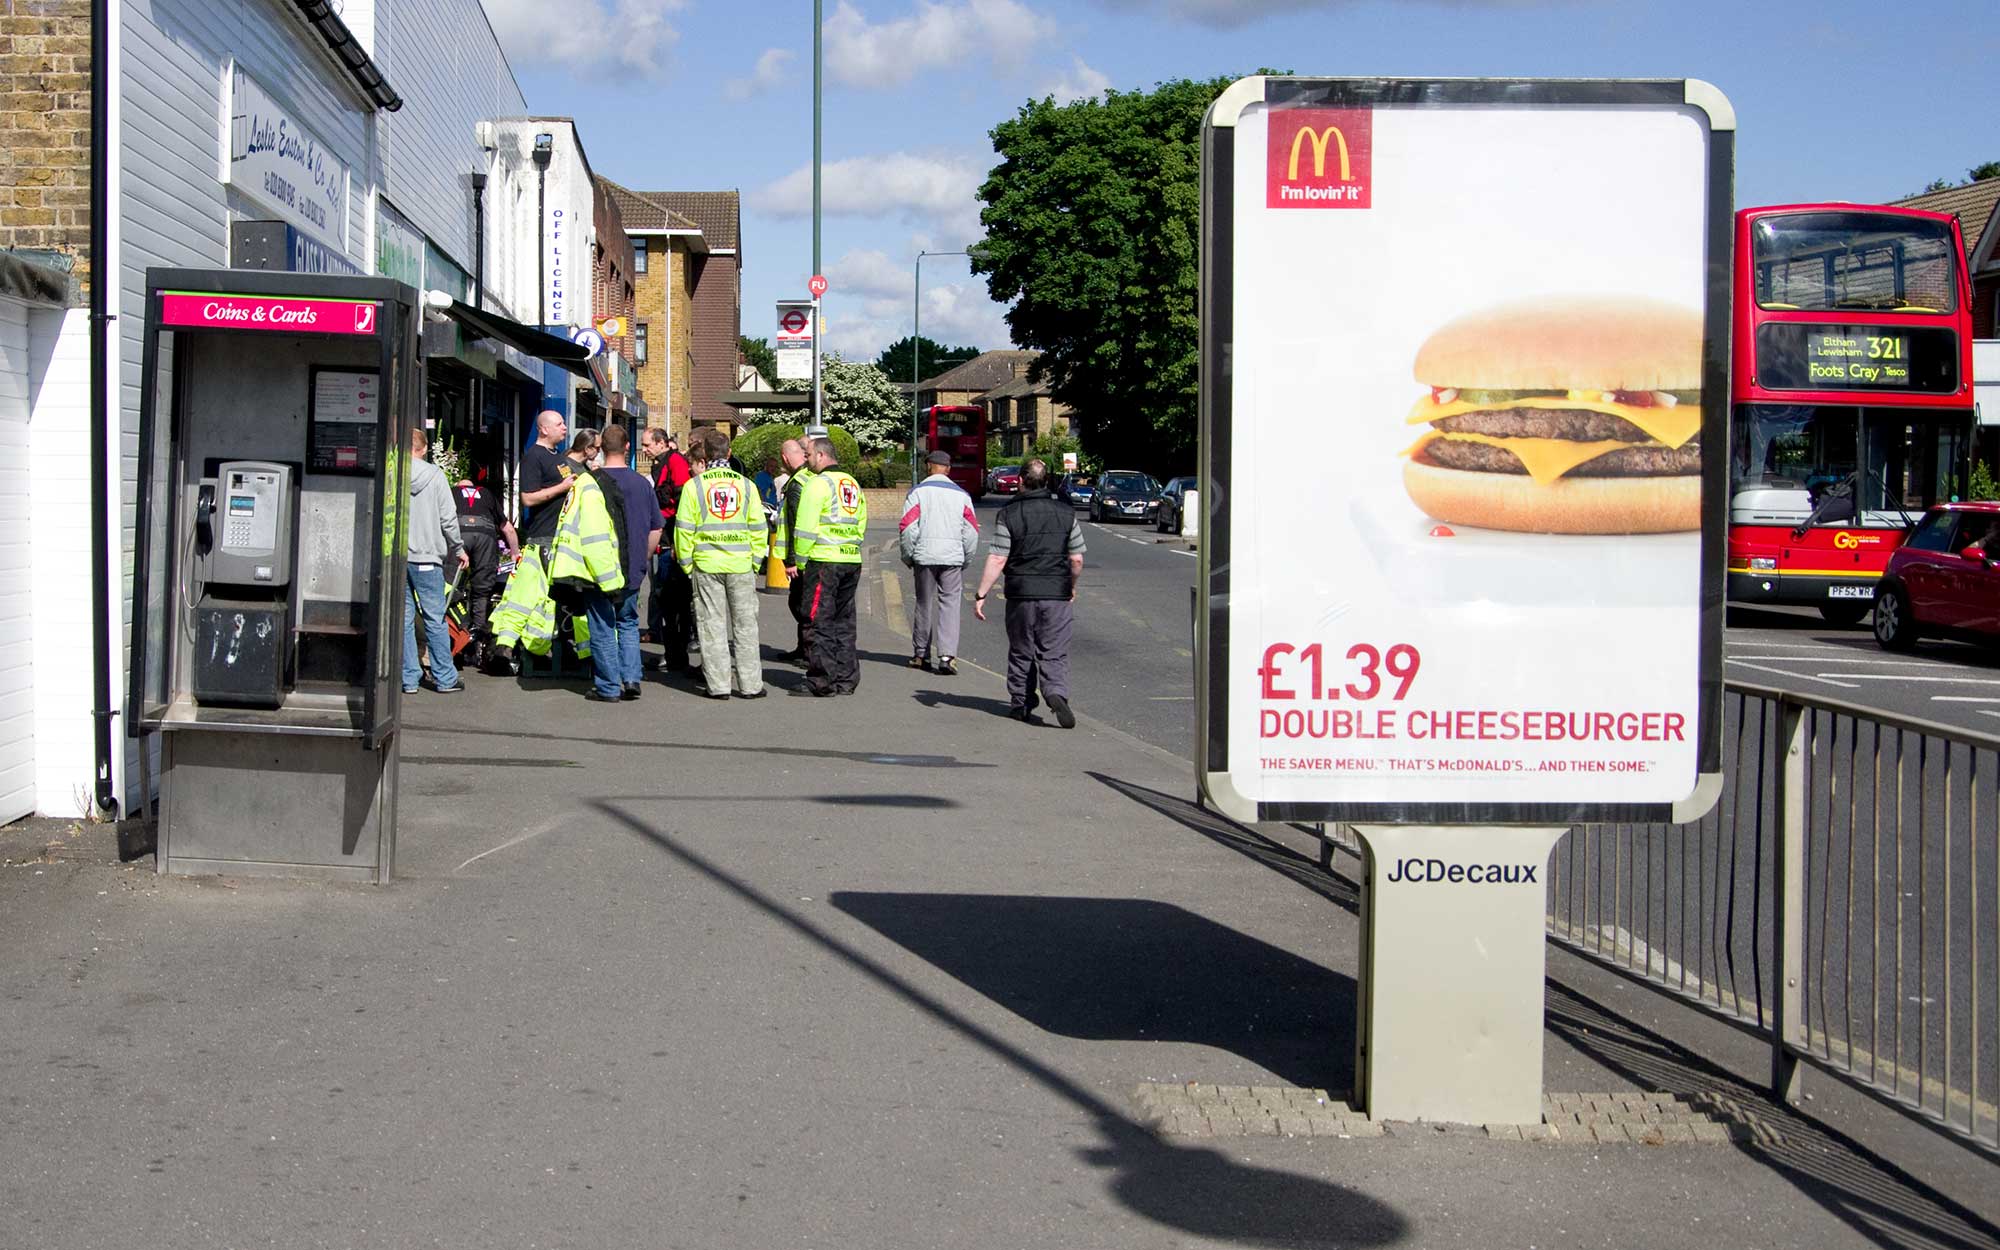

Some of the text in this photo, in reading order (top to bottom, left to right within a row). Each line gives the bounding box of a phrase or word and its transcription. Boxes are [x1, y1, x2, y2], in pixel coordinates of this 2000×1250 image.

[248, 114, 275, 154] Leslie
[307, 140, 313, 172] &
[1281, 185, 1304, 200] i'm
[1305, 185, 1345, 200] lovin'
[553, 209, 563, 321] OFF LICENCE
[811, 280, 826, 290] FU
[203, 302, 317, 324] Coins & Cards
[1817, 347, 1863, 357] Lewisham
[1823, 337, 1857, 347] Eltham
[1866, 336, 1901, 359] 321
[1810, 363, 1906, 381] Foots Cray Tesco
[1832, 586, 1857, 596] PF52
[1257, 642, 1422, 701] £1.39
[1259, 709, 1685, 742] DOUBLE CHEESEBURGER
[1260, 757, 1286, 770] THE
[1288, 757, 1332, 771] SAVER
[1389, 758, 1435, 771] THAT'S
[1570, 760, 1607, 773] THEN
[1387, 859, 1537, 884] JCDecaux
